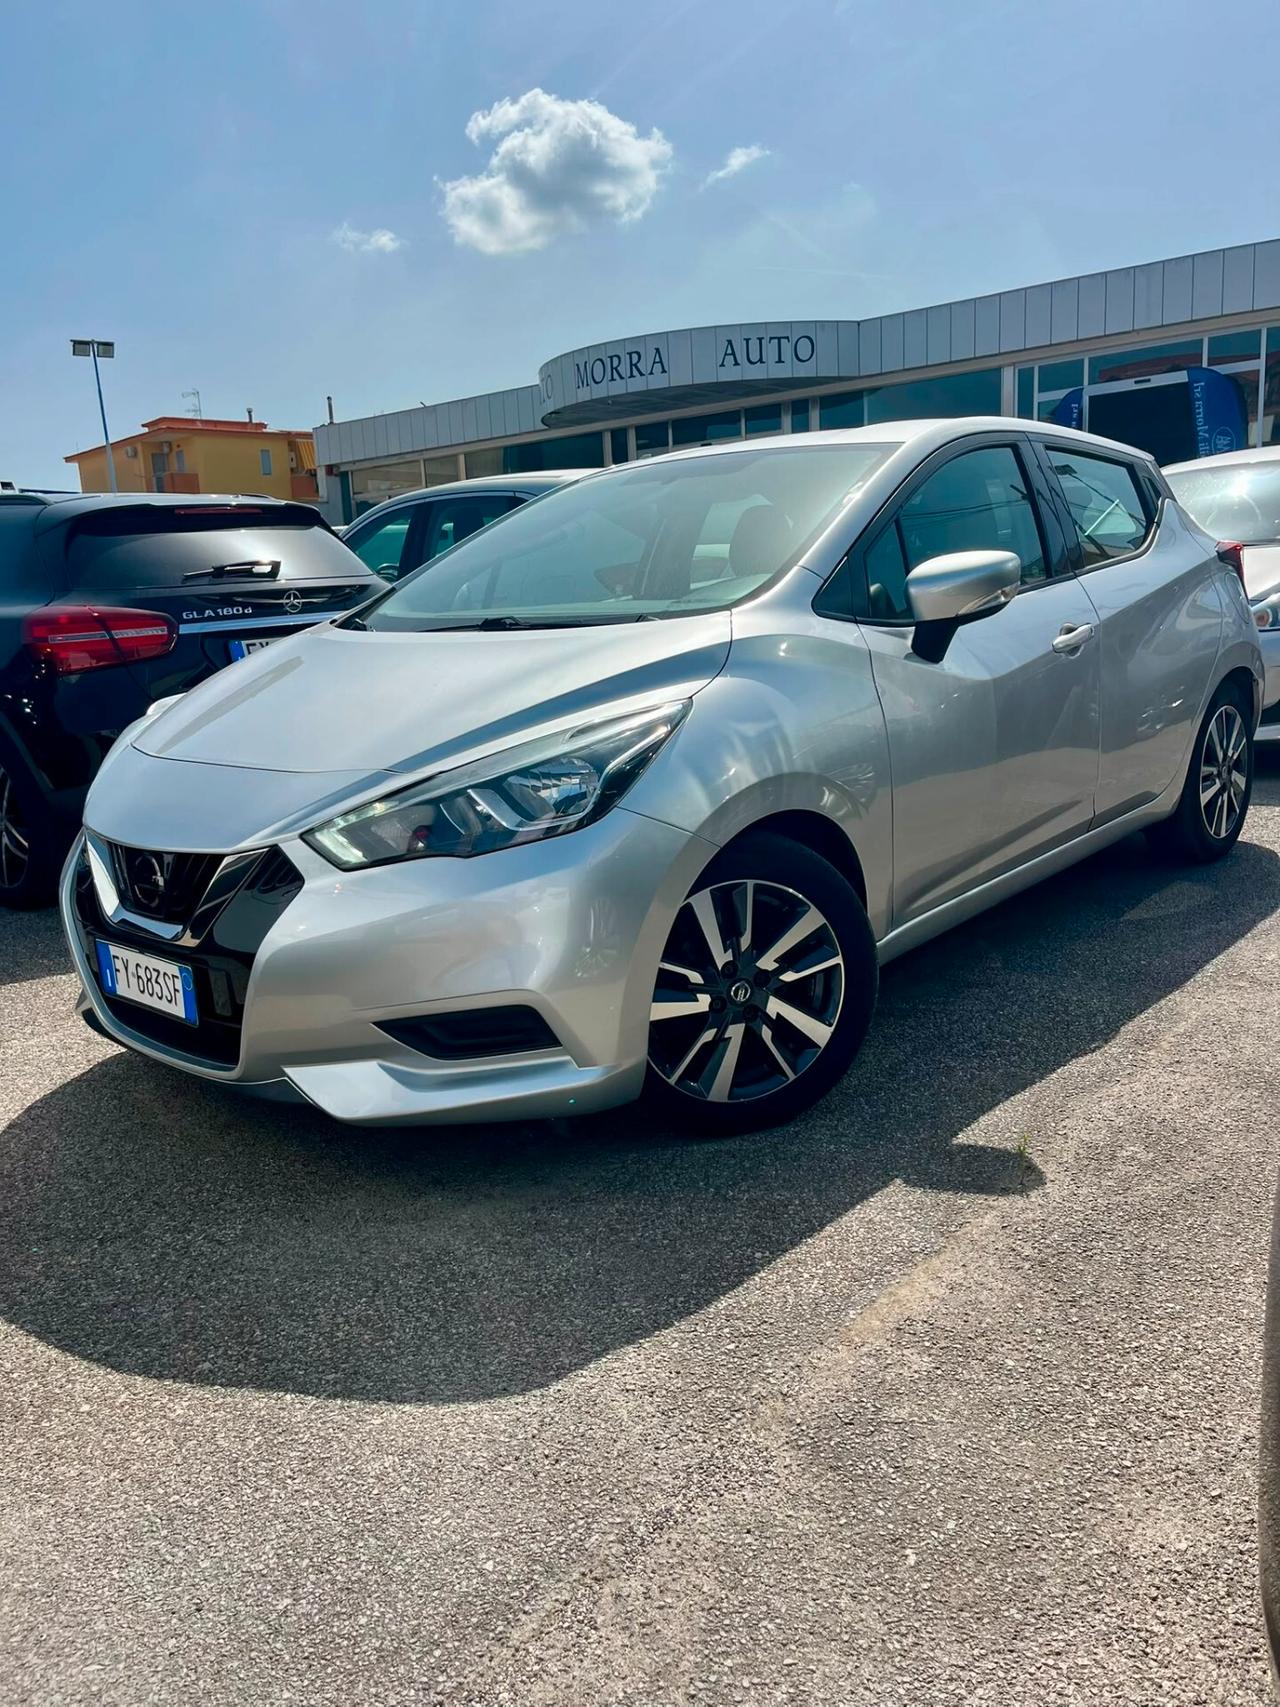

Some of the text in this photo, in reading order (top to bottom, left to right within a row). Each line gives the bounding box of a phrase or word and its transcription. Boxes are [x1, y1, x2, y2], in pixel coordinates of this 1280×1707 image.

[575, 347, 668, 390] MORRA
[718, 334, 816, 368] AUTO
[182, 609, 216, 620] GLA
